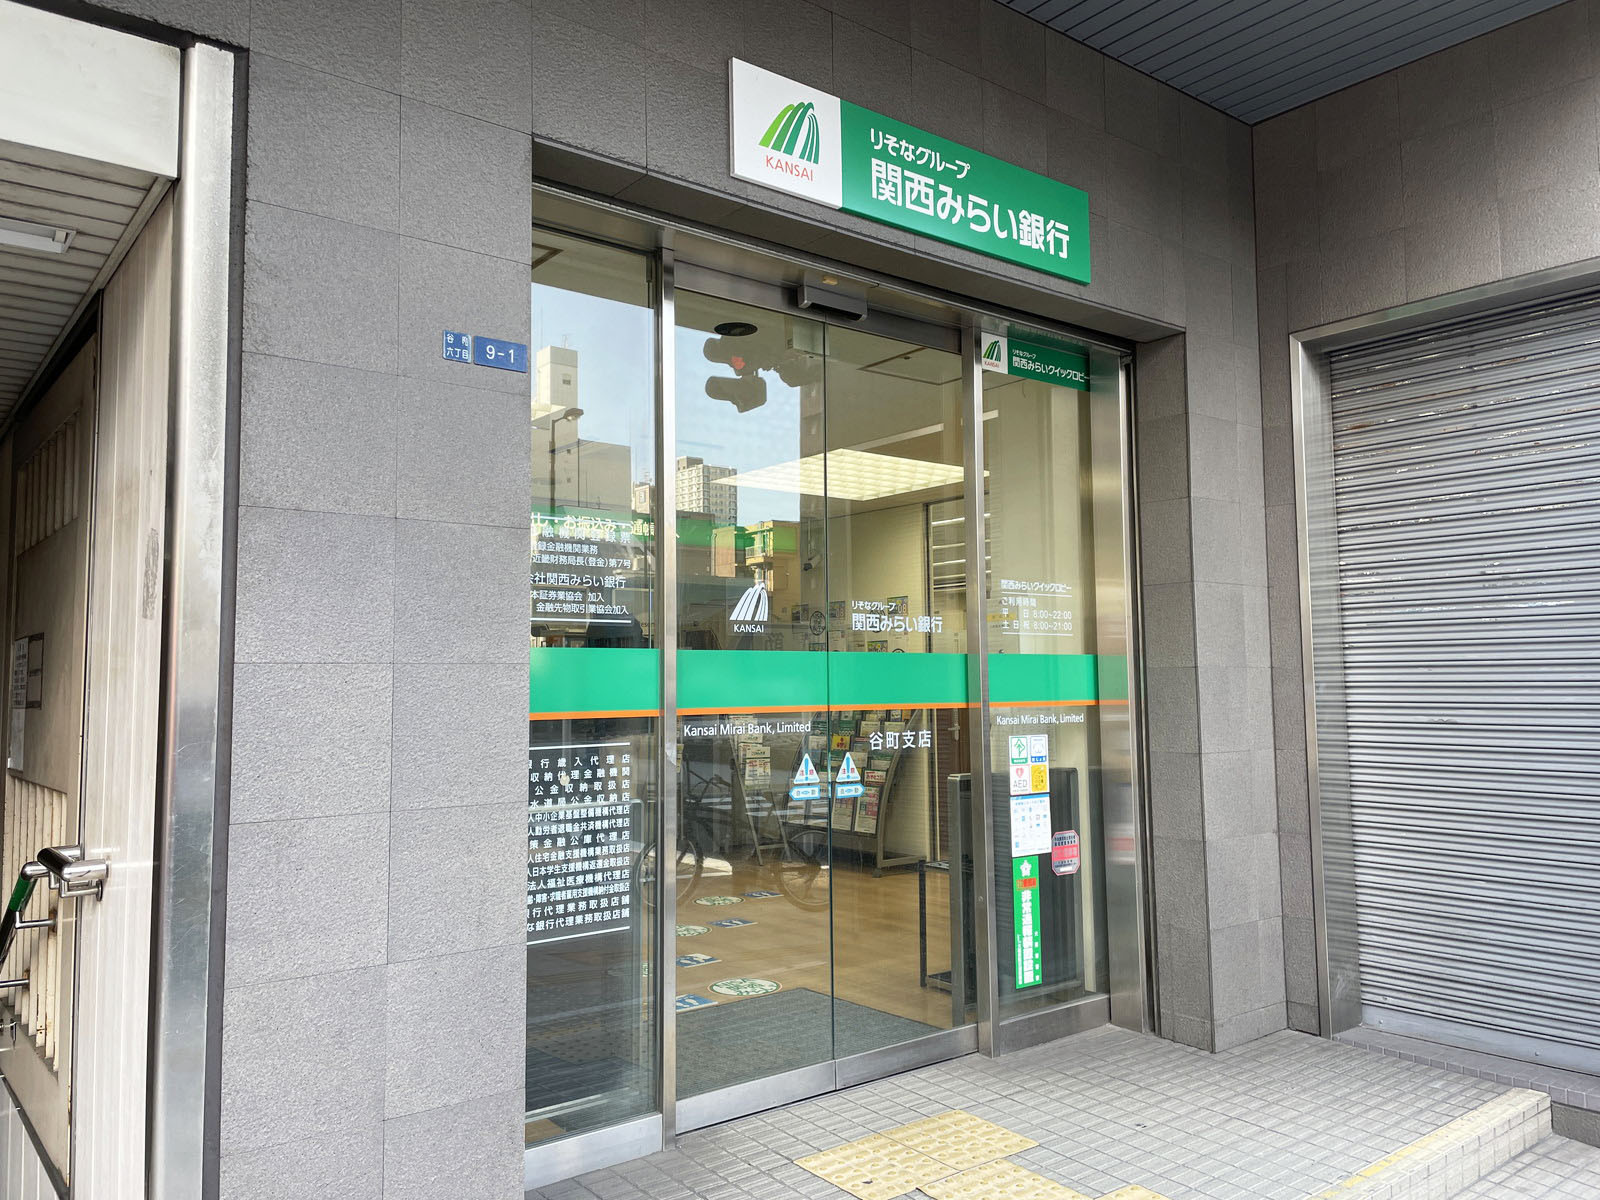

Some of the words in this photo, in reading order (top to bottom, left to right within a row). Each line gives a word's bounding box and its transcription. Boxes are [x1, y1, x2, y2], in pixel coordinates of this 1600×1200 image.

[870, 128, 971, 180] りそなグループ
[765, 154, 815, 183] KANSAI
[871, 157, 1070, 259] 関西みらい銀行
[446, 347, 469, 360] 六丁目
[486, 345, 514, 364] 9-1
[984, 361, 1000, 369] KANSAI
[1012, 356, 1090, 382] 関西みらいクイックロビー
[588, 592, 605, 602] 加入
[536, 602, 629, 615] 金融先物取引業協会加入
[852, 600, 897, 612] りそなグループ
[733, 623, 764, 633] KANSAI
[852, 613, 943, 633] 関西みらい銀行
[996, 715, 1020, 726] Kansai
[1021, 714, 1039, 725] Mirai
[1040, 714, 1059, 725] Bank,
[1060, 713, 1084, 724] Limited
[684, 724, 718, 737] Kansai
[720, 722, 745, 736] Mirai
[748, 722, 775, 735] Bank,
[777, 721, 811, 734] Limited
[869, 730, 932, 750] 谷町支店
[527, 895, 630, 919] 行代理業務取扱店舗
